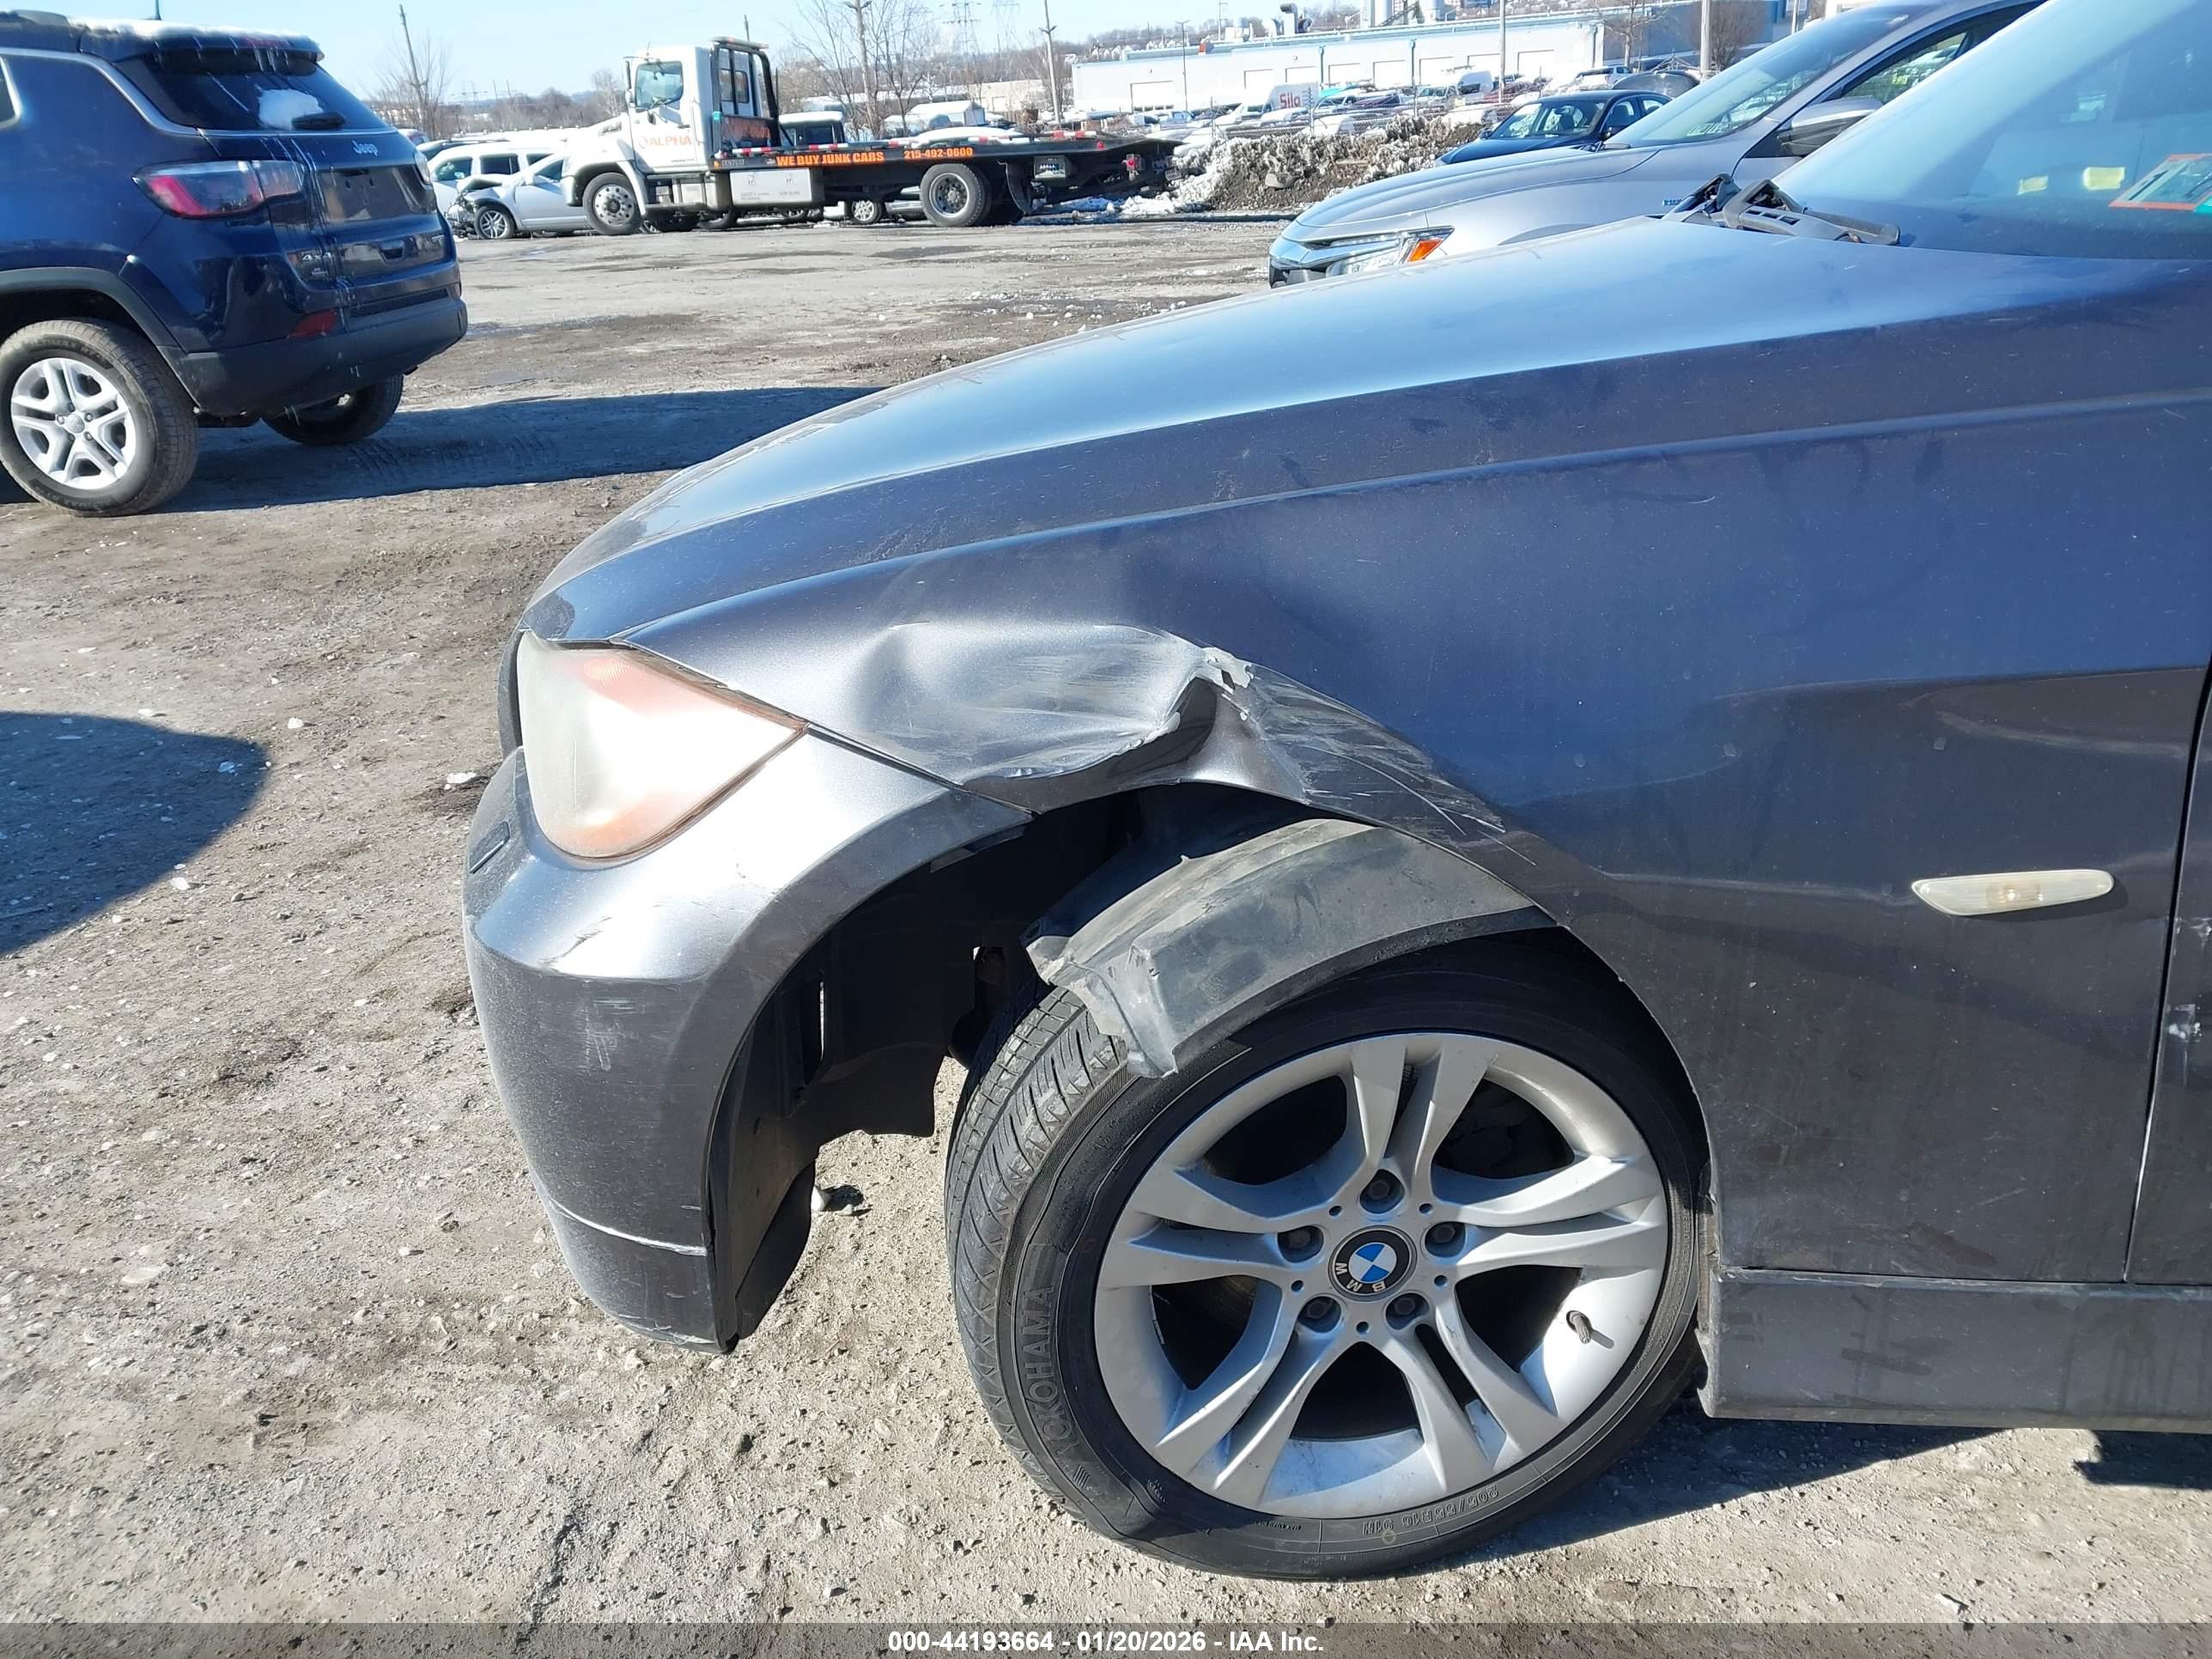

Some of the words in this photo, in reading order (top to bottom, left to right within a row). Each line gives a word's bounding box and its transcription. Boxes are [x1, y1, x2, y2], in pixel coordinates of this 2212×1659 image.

[1279, 92, 1301, 109] Sila
[352, 140, 378, 156] Jeep
[649, 136, 692, 145] ALPHA
[776, 155, 795, 166] WE
[796, 155, 819, 165] BUY
[822, 153, 850, 164] JUNK
[854, 151, 884, 163] CARS
[904, 147, 973, 159] 215-492-0600
[1335, 1262, 1386, 1292] BMW
[1022, 1285, 1079, 1456] YOKOHAMA
